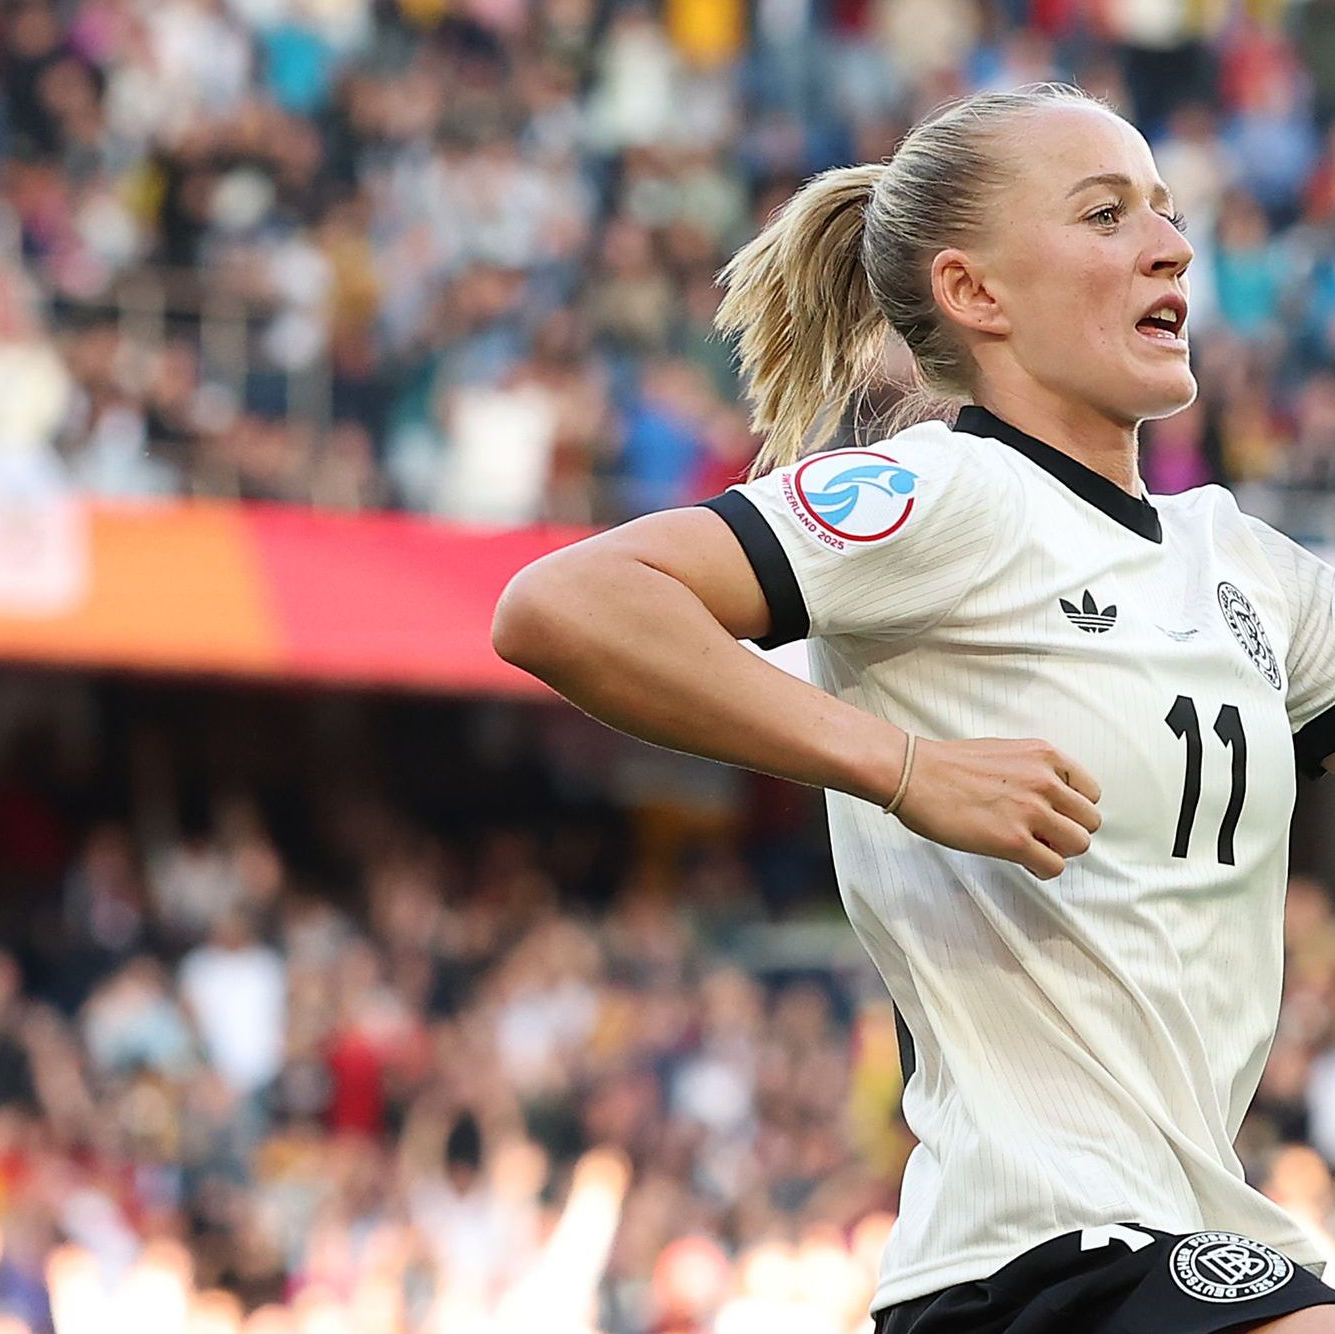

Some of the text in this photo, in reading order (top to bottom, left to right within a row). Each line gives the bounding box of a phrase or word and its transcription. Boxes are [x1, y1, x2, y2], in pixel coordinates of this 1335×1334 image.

[781, 473, 845, 550] SWITZERLAND 2025
[1164, 694, 1248, 867] 11
[1176, 1248, 1238, 1298] DEUTSCHER
